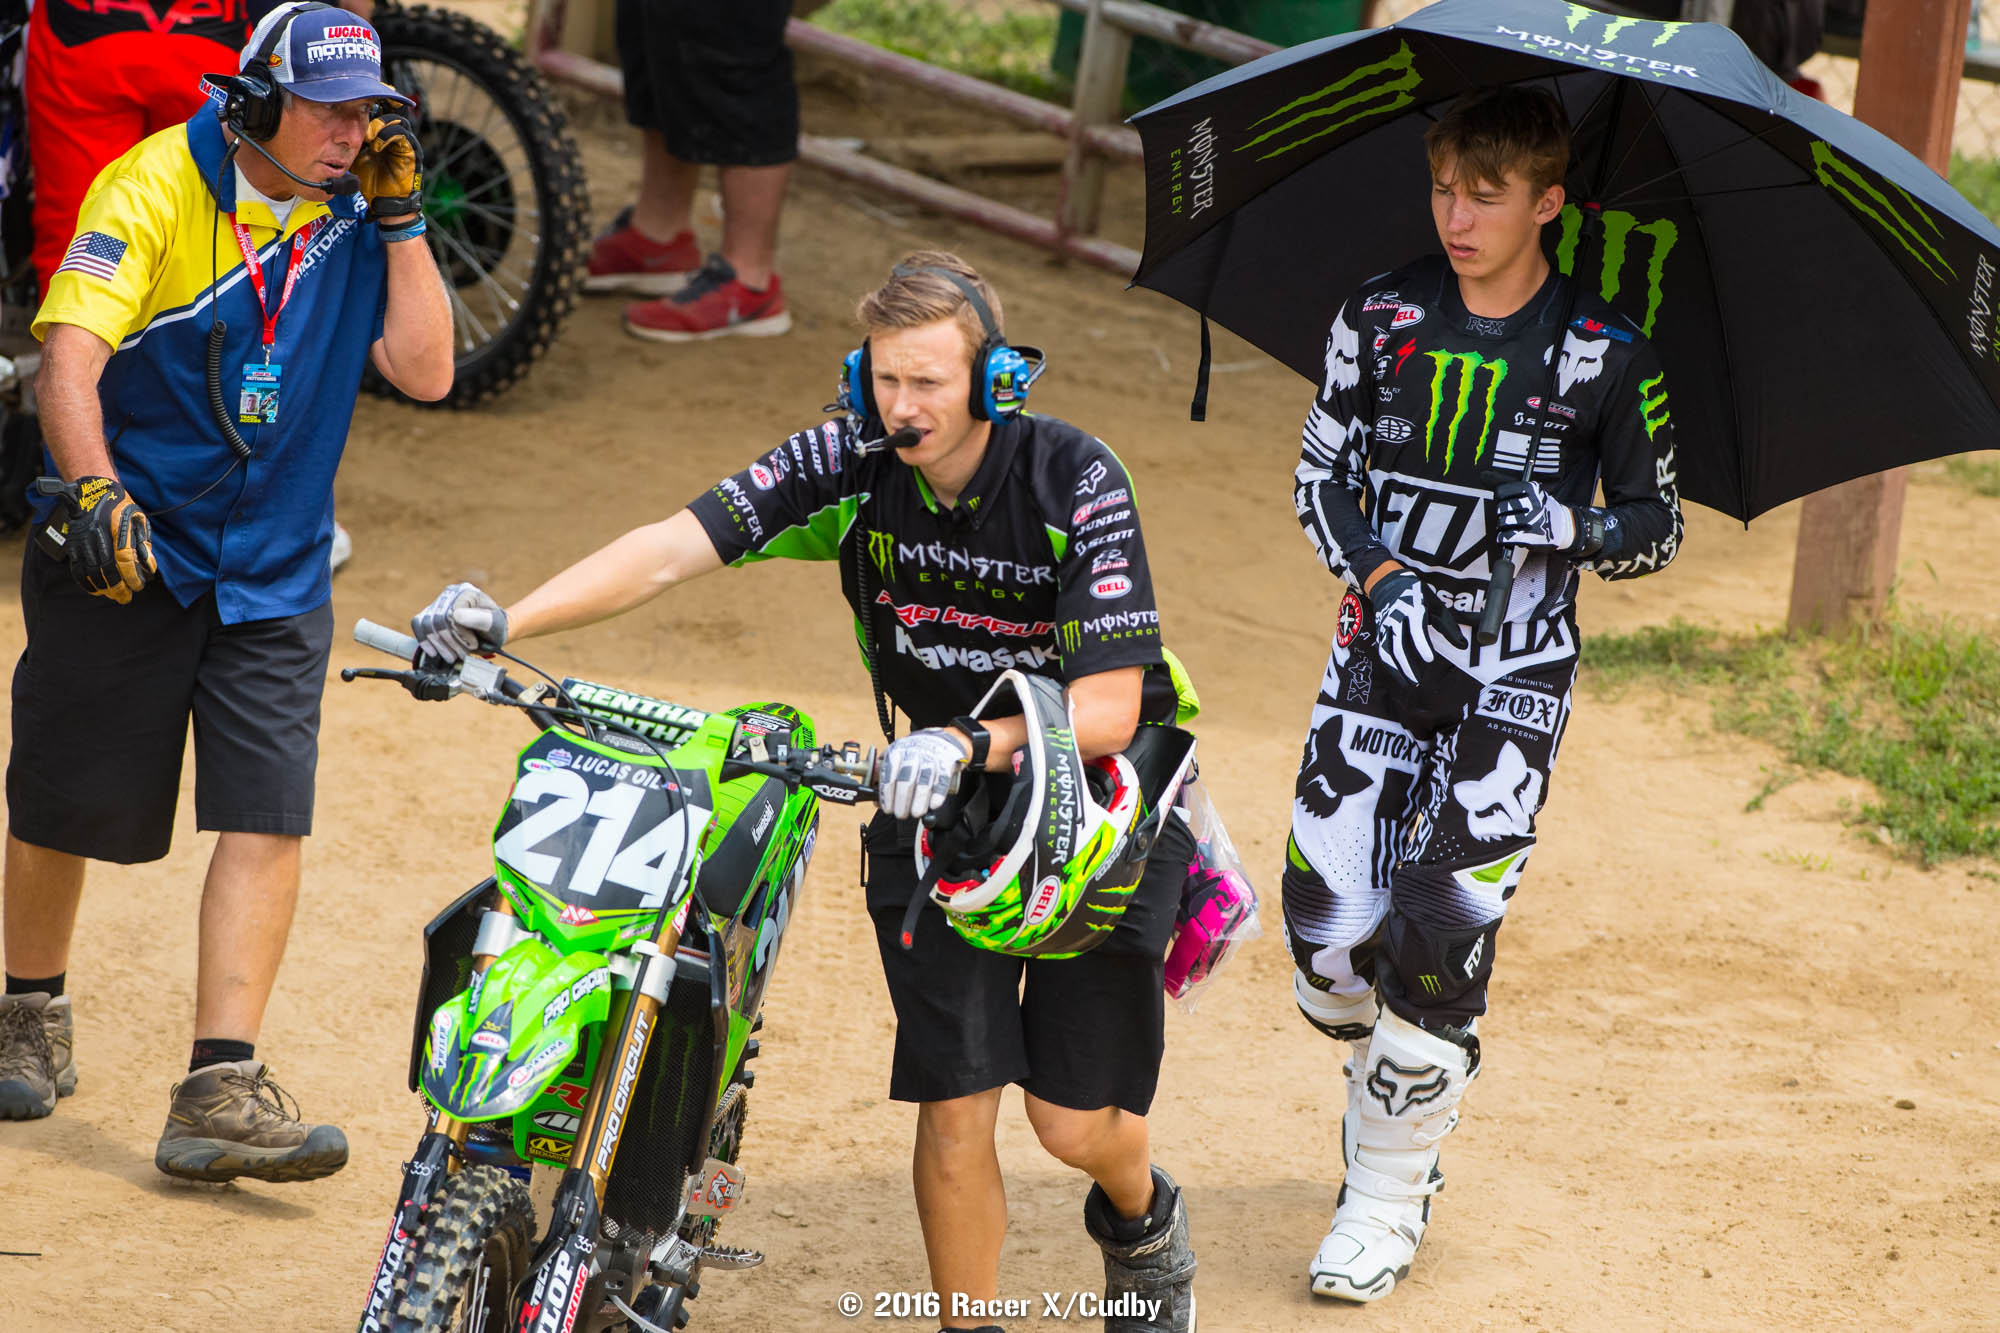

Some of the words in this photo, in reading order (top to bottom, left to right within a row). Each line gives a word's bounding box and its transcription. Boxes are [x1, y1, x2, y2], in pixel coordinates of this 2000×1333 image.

[328, 26, 361, 39] LUCAS
[1495, 25, 1700, 78] MONSTER
[1522, 42, 1666, 78] ENERGY
[1170, 148, 1183, 215] ENERGY
[1187, 116, 1219, 219] MONSTER
[1966, 252, 1996, 359] MONSTER
[1524, 417, 1570, 431] SOTT
[899, 541, 1055, 585] MONSTER
[1097, 581, 1127, 593] BELL
[1083, 611, 1159, 633] MONSTE
[895, 624, 1061, 673] Kawasak
[569, 683, 707, 728] RENTHA
[1515, 677, 1553, 691] INFINITUM
[1481, 688, 1556, 728] FOX
[1487, 722, 1498, 730] AB
[1501, 726, 1539, 741] AETERNO
[571, 754, 630, 780] LUCAS
[631, 768, 663, 790] OIL
[1051, 753, 1077, 865] MONSTER
[494, 767, 714, 910] 214
[1030, 884, 1056, 920] BELL
[613, 1010, 649, 1115] CIRCUIT
[597, 1111, 621, 1172] PRO
